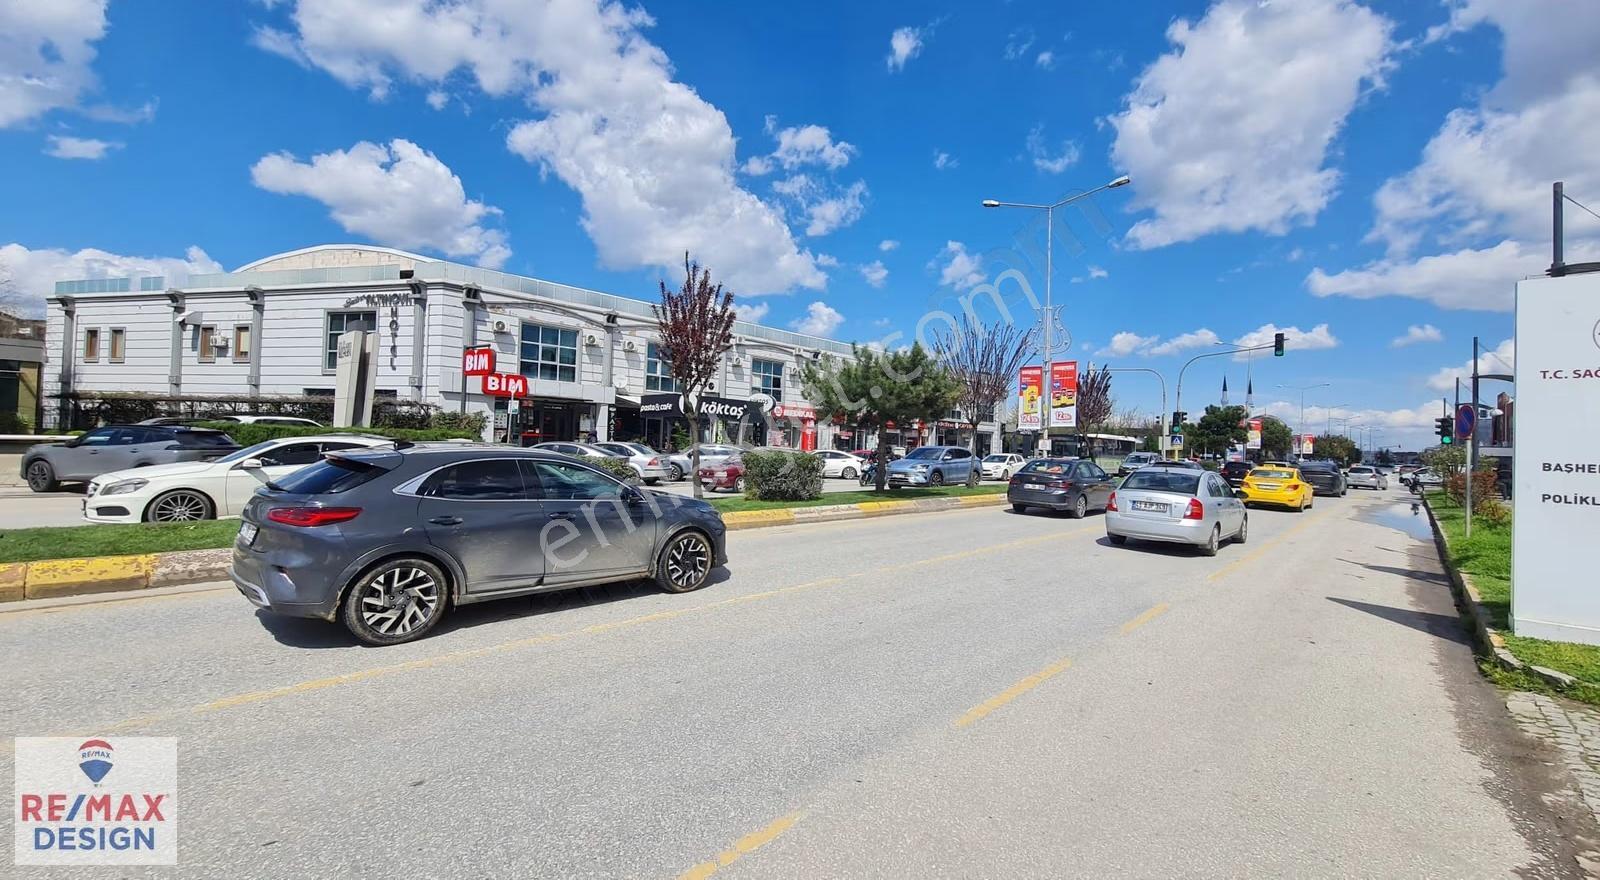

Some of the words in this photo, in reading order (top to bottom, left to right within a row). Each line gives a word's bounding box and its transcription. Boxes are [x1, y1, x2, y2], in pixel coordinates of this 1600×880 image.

[1540, 370, 1568, 380] T.C.
[700, 401, 744, 419] köktaş
[1542, 462, 1600, 474] BAŞHE
[1542, 493, 1600, 506] POLİKL
